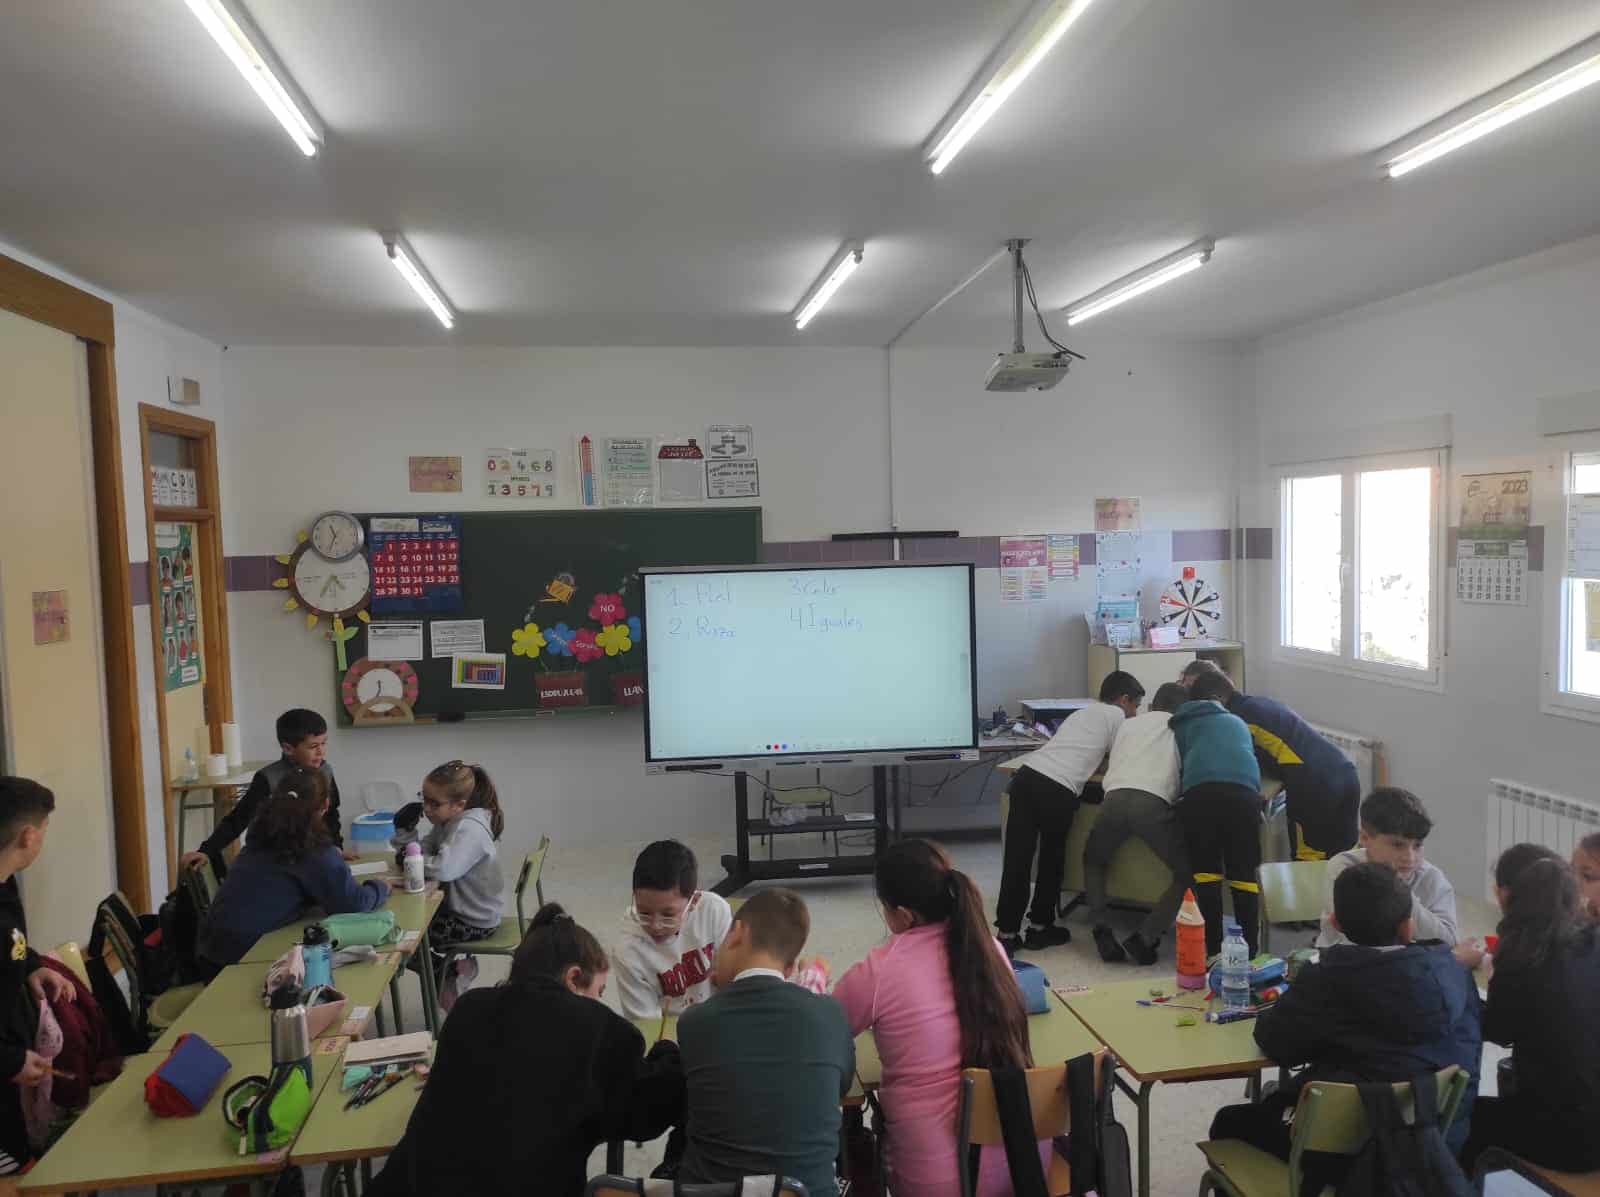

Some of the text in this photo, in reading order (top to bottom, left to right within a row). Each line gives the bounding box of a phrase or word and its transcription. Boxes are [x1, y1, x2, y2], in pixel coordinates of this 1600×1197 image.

[488, 459, 496, 471] 0
[531, 461, 540, 472] 6
[545, 459, 553, 472] 8
[488, 484, 496, 495] 1
[502, 484, 511, 496] 3
[518, 485, 526, 496] 5
[531, 485, 540, 496] 7
[1502, 480, 1529, 494] 2023
[600, 604, 615, 613] NO
